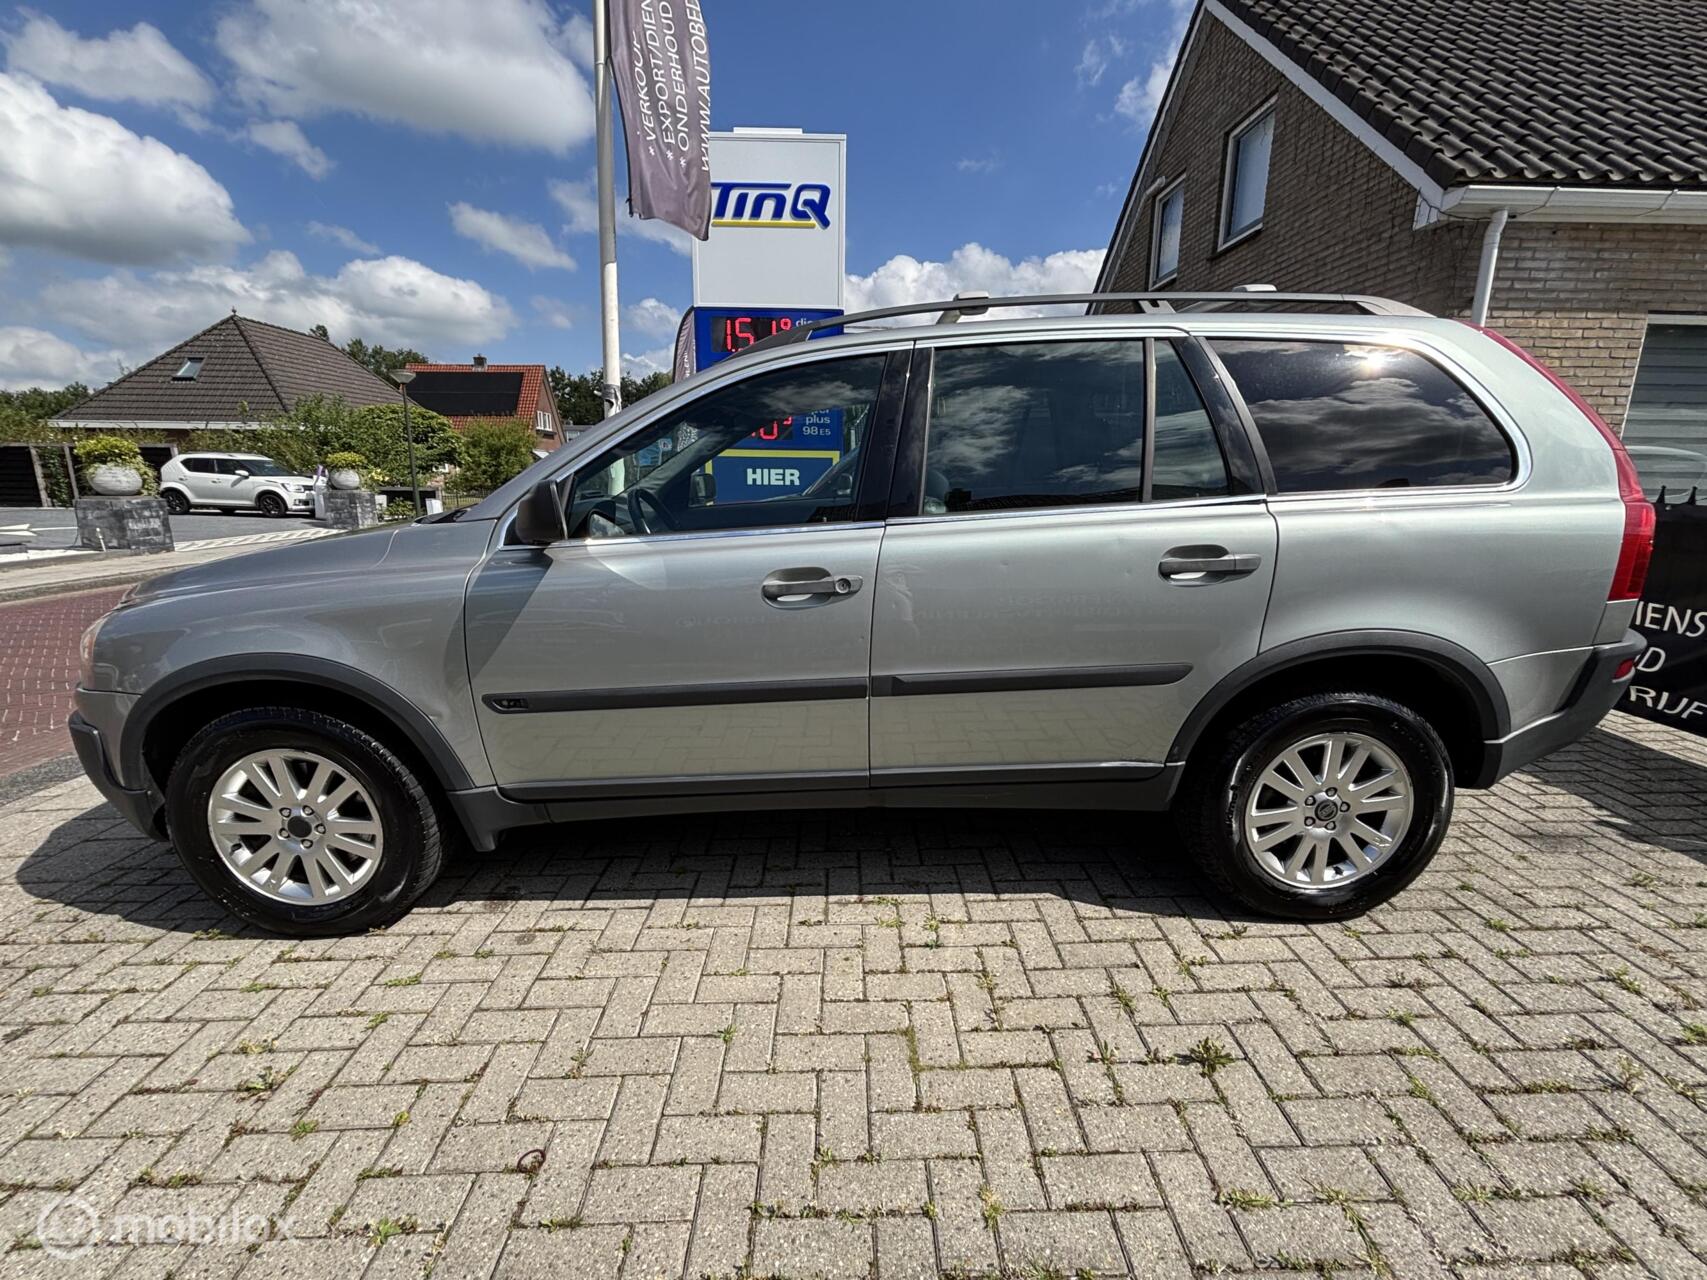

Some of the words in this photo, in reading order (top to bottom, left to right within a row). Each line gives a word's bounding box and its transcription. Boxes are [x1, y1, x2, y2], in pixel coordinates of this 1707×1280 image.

[659, 1, 689, 151] ONDERHOUD
[805, 415, 831, 425] plus
[746, 468, 800, 485] HIER
[1633, 646, 1666, 672] D
